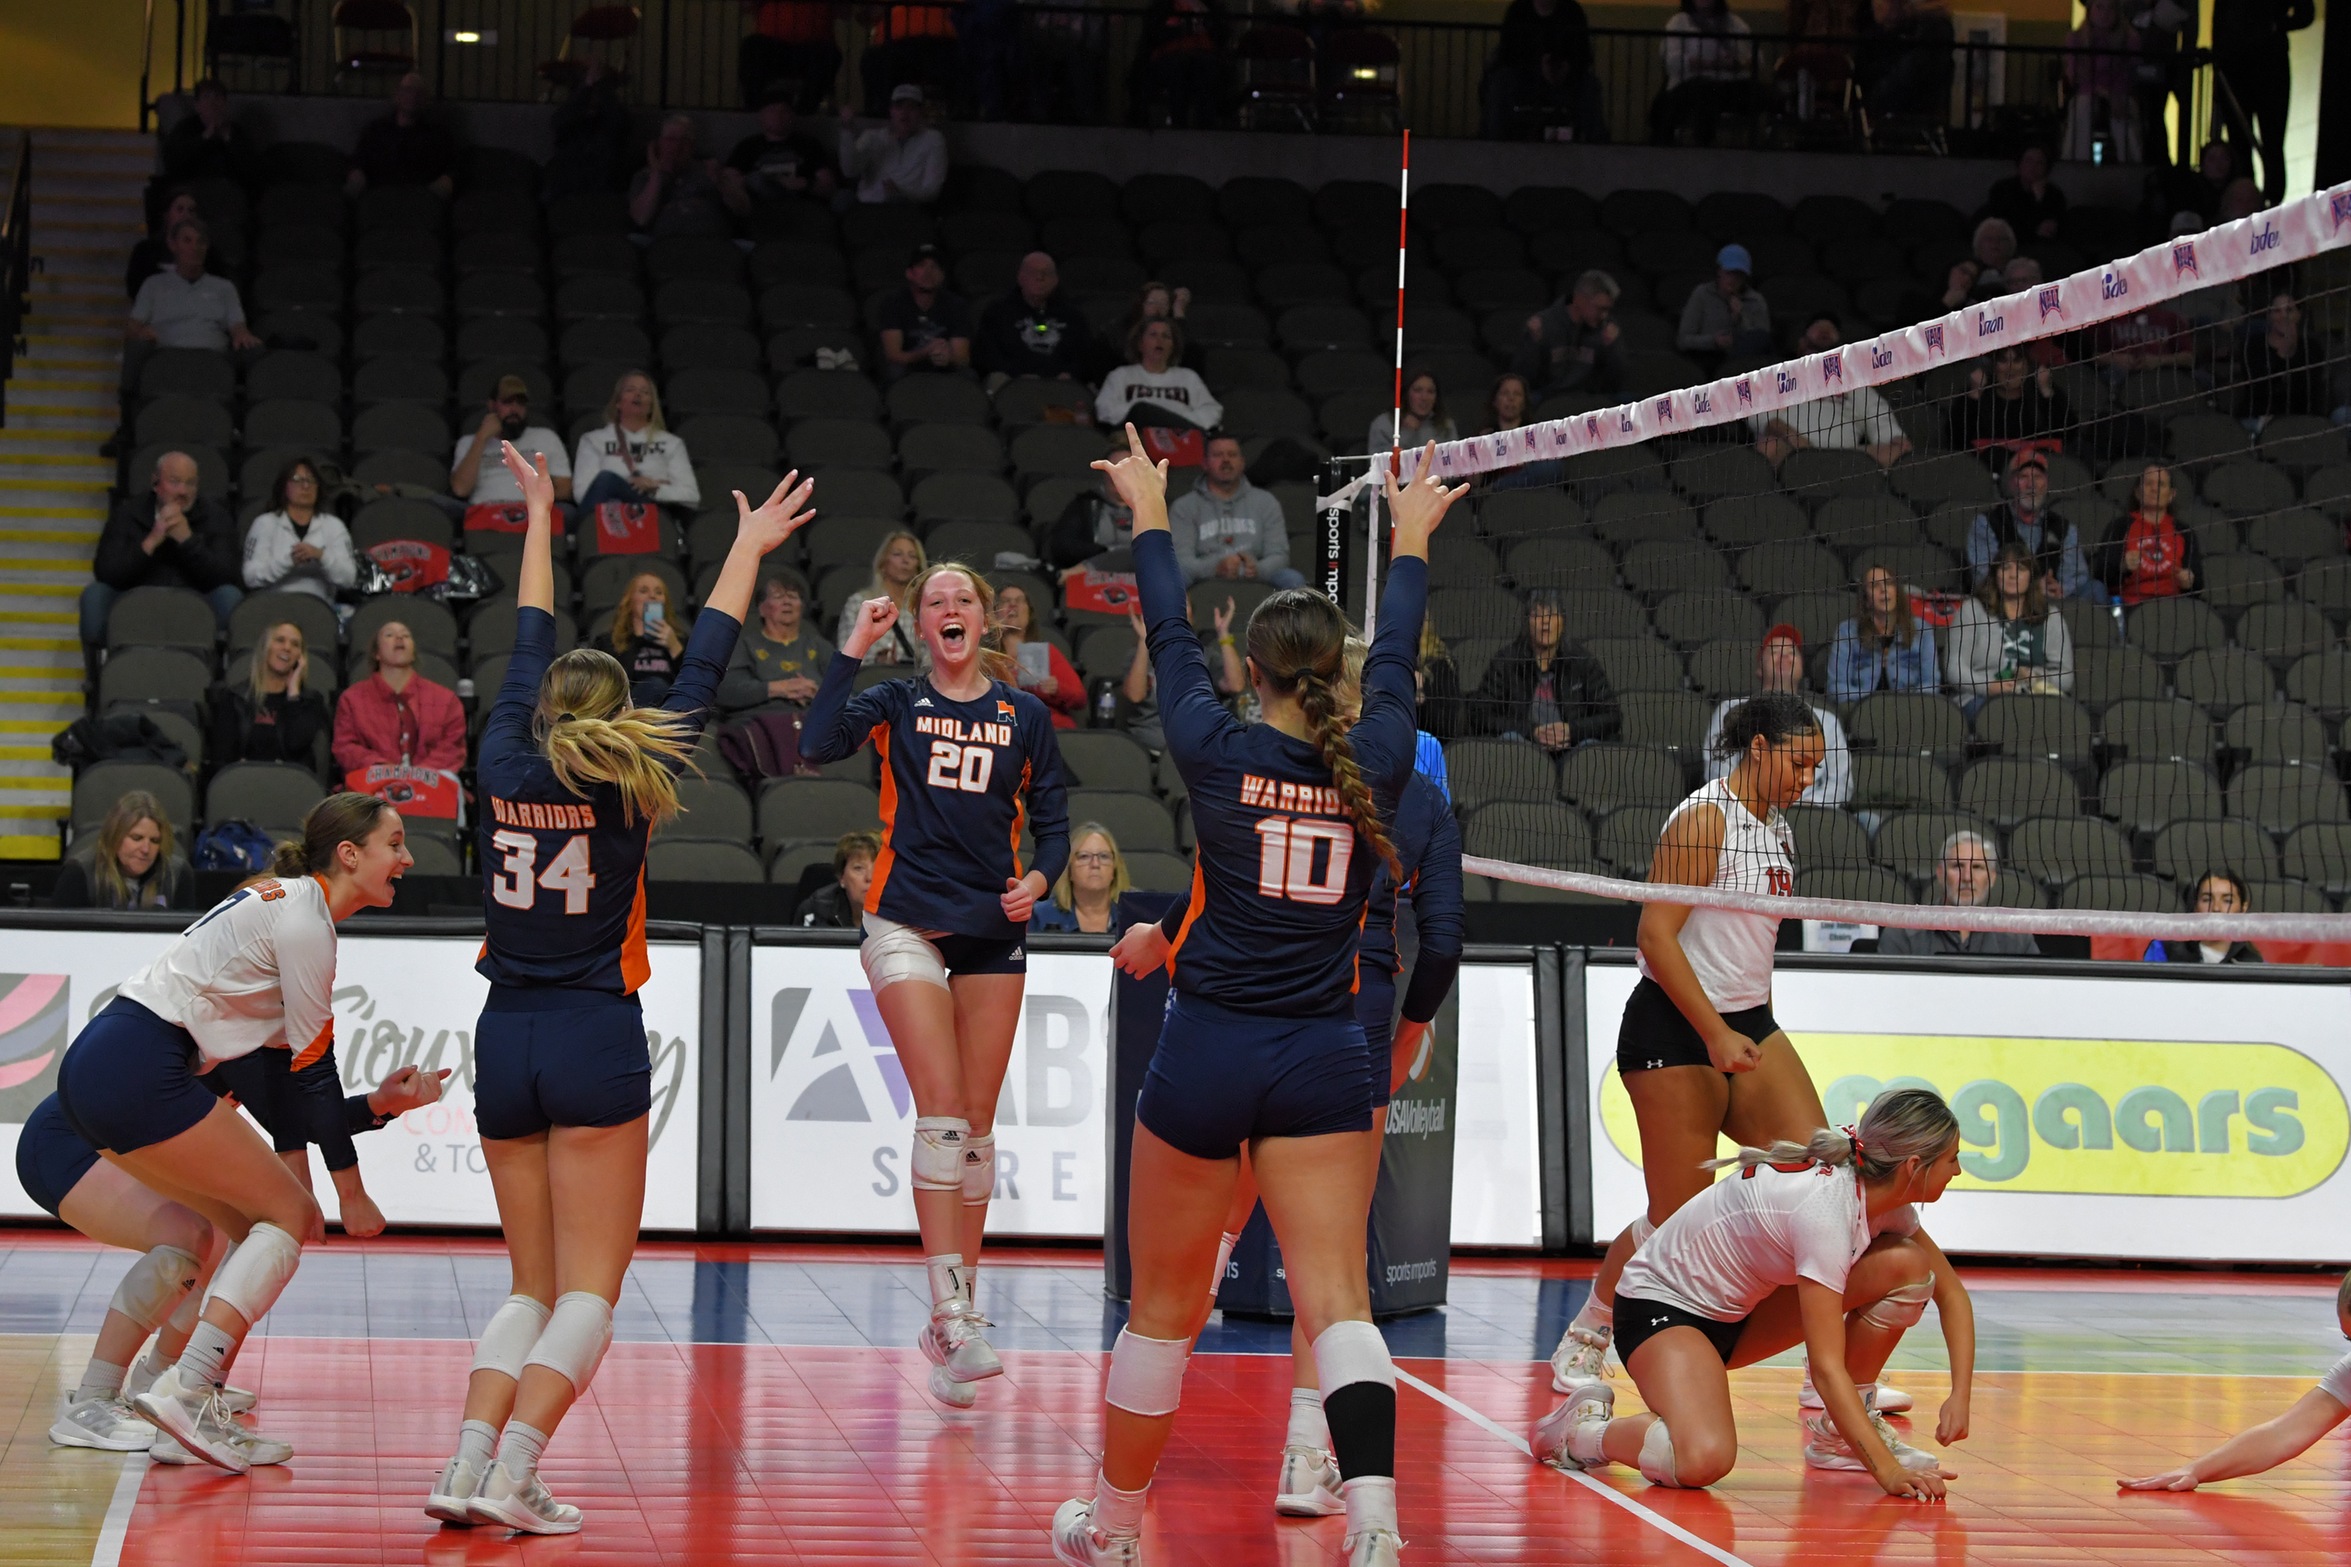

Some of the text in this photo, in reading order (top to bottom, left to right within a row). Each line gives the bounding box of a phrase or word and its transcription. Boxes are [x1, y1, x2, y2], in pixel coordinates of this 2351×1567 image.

[1327, 508, 1341, 560] sports
[915, 715, 1012, 748] MIDLAND
[365, 764, 440, 789] CHAMPIONS
[927, 740, 994, 793] 20
[491, 795, 597, 831] WARRIORS
[1240, 776, 1354, 817] WARRIO
[492, 829, 597, 916] 34
[1254, 814, 1355, 906] 10
[1765, 867, 1793, 898] 19
[414, 1143, 437, 1173] &
